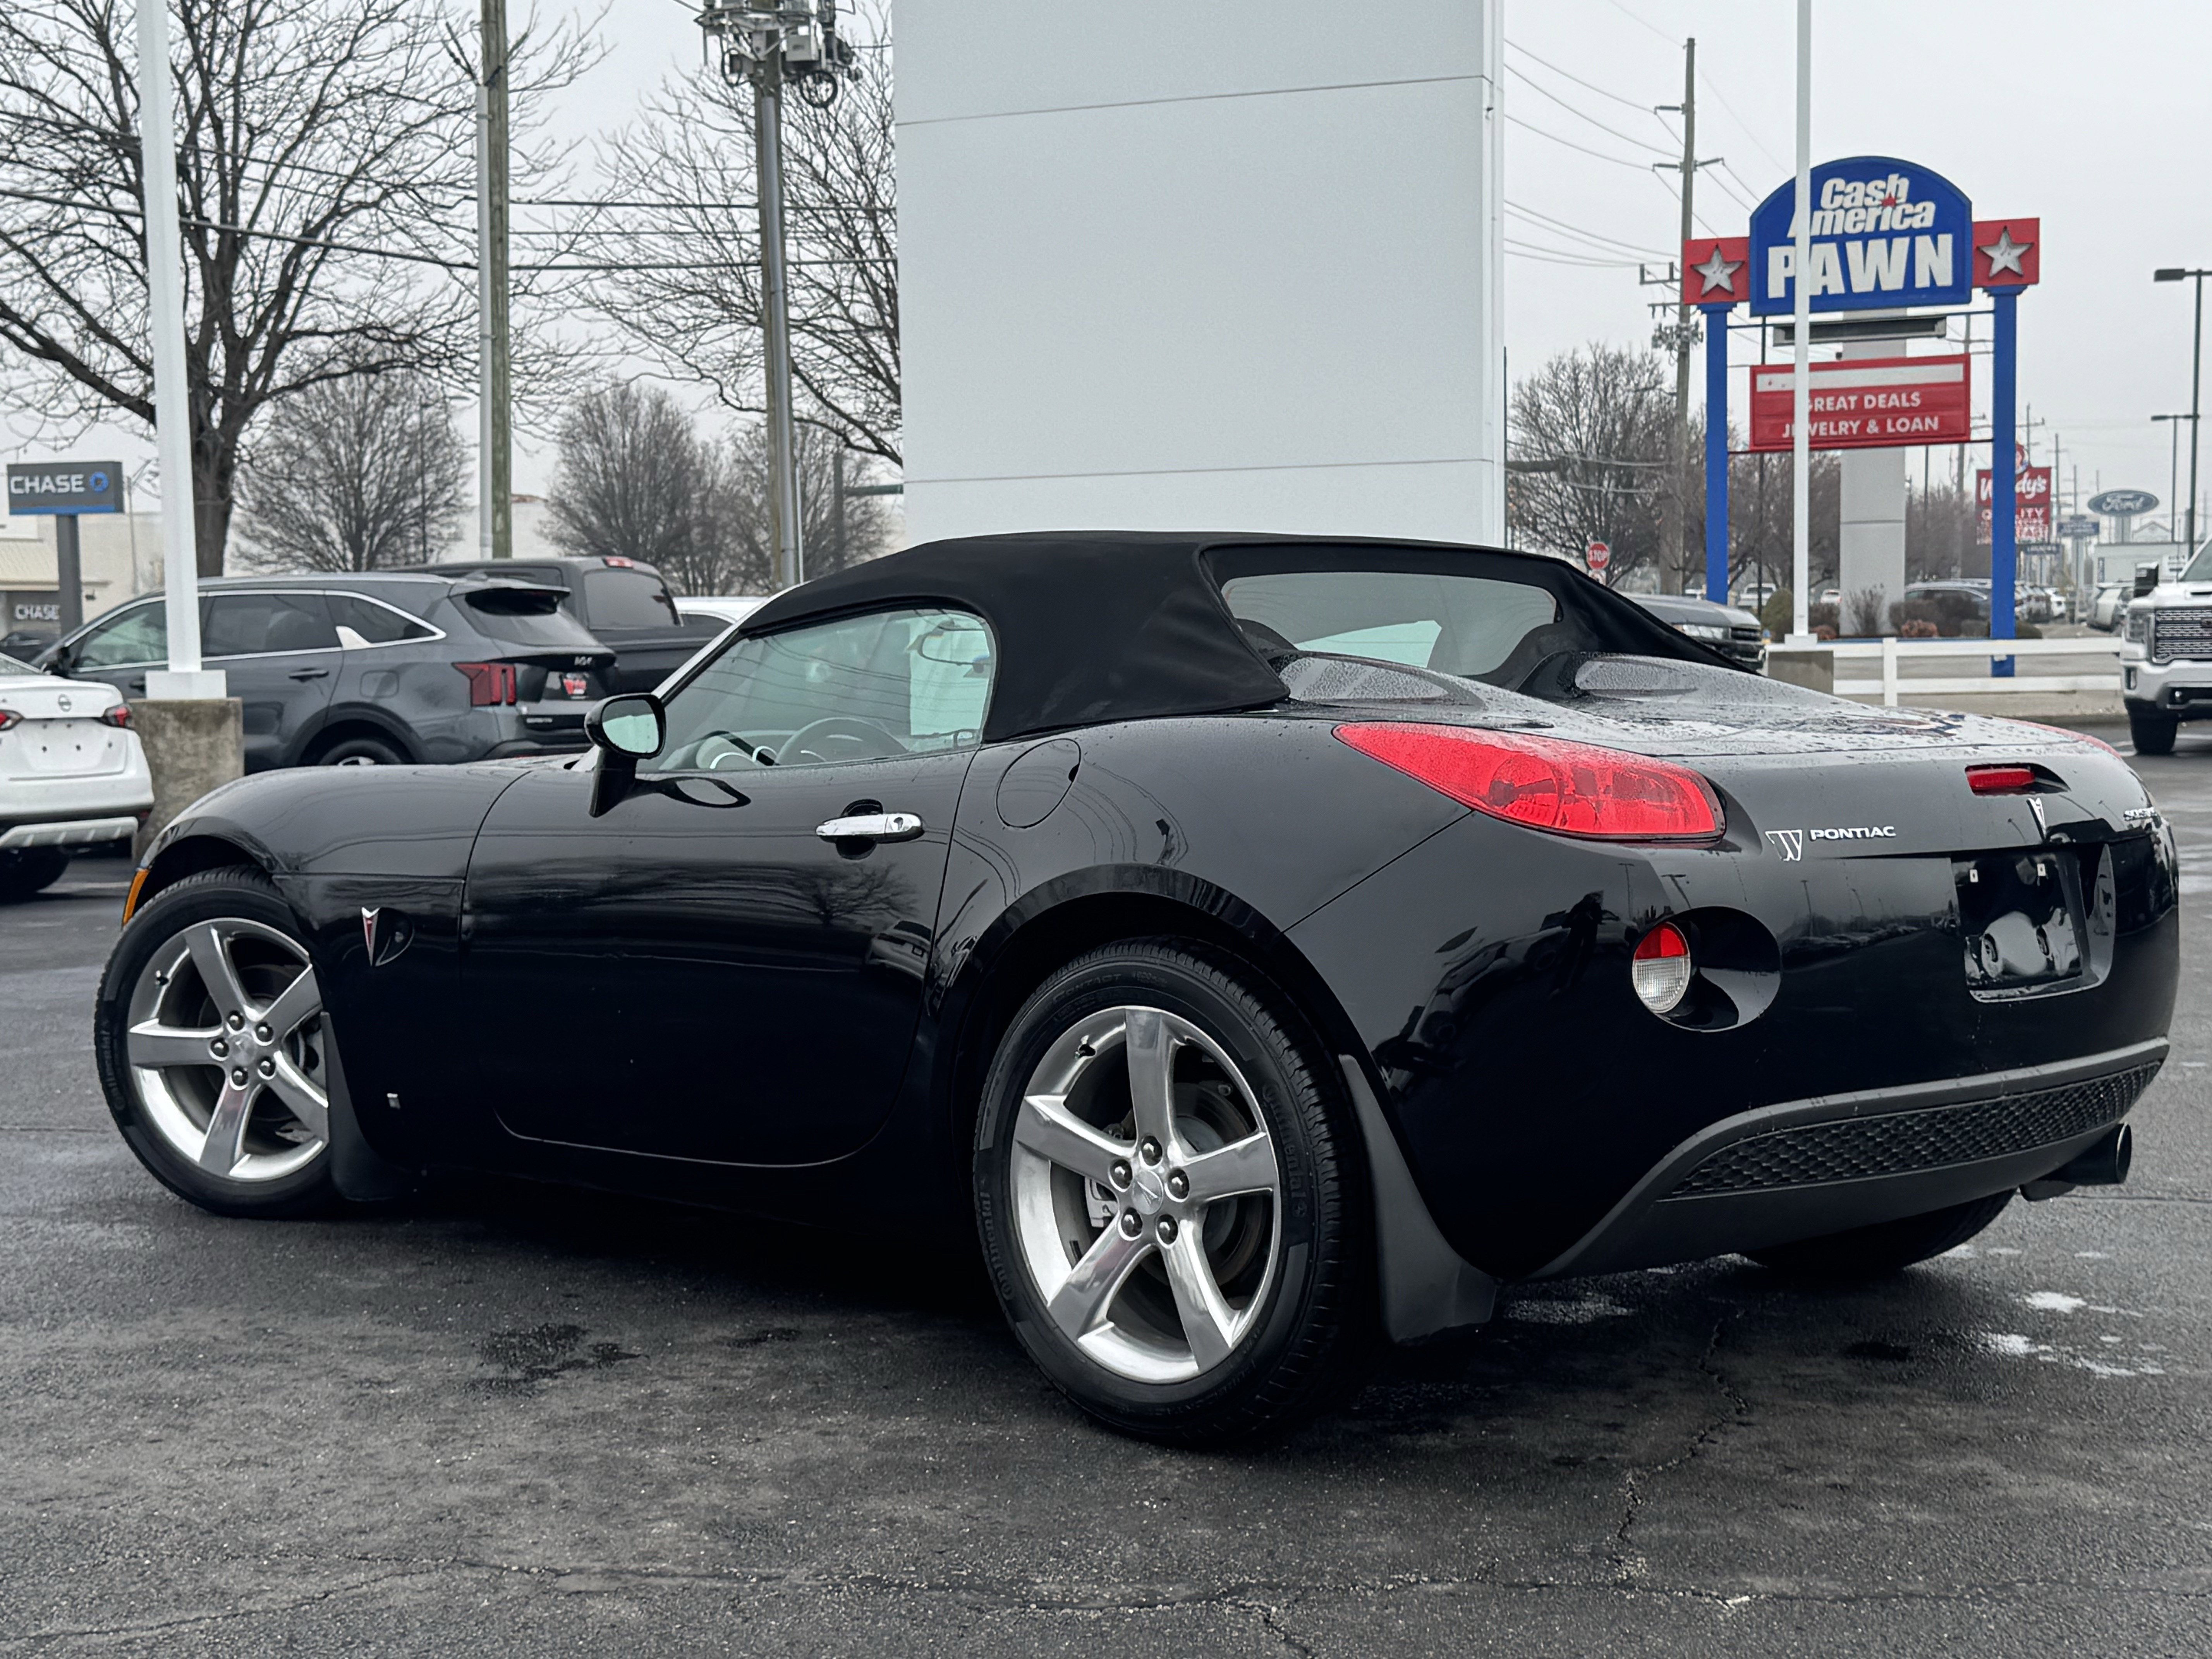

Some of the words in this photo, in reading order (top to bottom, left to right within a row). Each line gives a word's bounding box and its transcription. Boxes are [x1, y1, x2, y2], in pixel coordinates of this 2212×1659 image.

[1821, 173, 1910, 210] Cash
[1768, 233, 1953, 299] PAWN
[1863, 392, 1921, 409] DEALS
[1866, 420, 1879, 434] &
[1887, 416, 1939, 433] LOAN
[10, 474, 86, 494] CHASE
[1980, 471, 2047, 501] Wdy's
[1589, 550, 1608, 562] STOP
[15, 604, 60, 620] CHASE
[1809, 826, 1897, 841] PONTIAC
